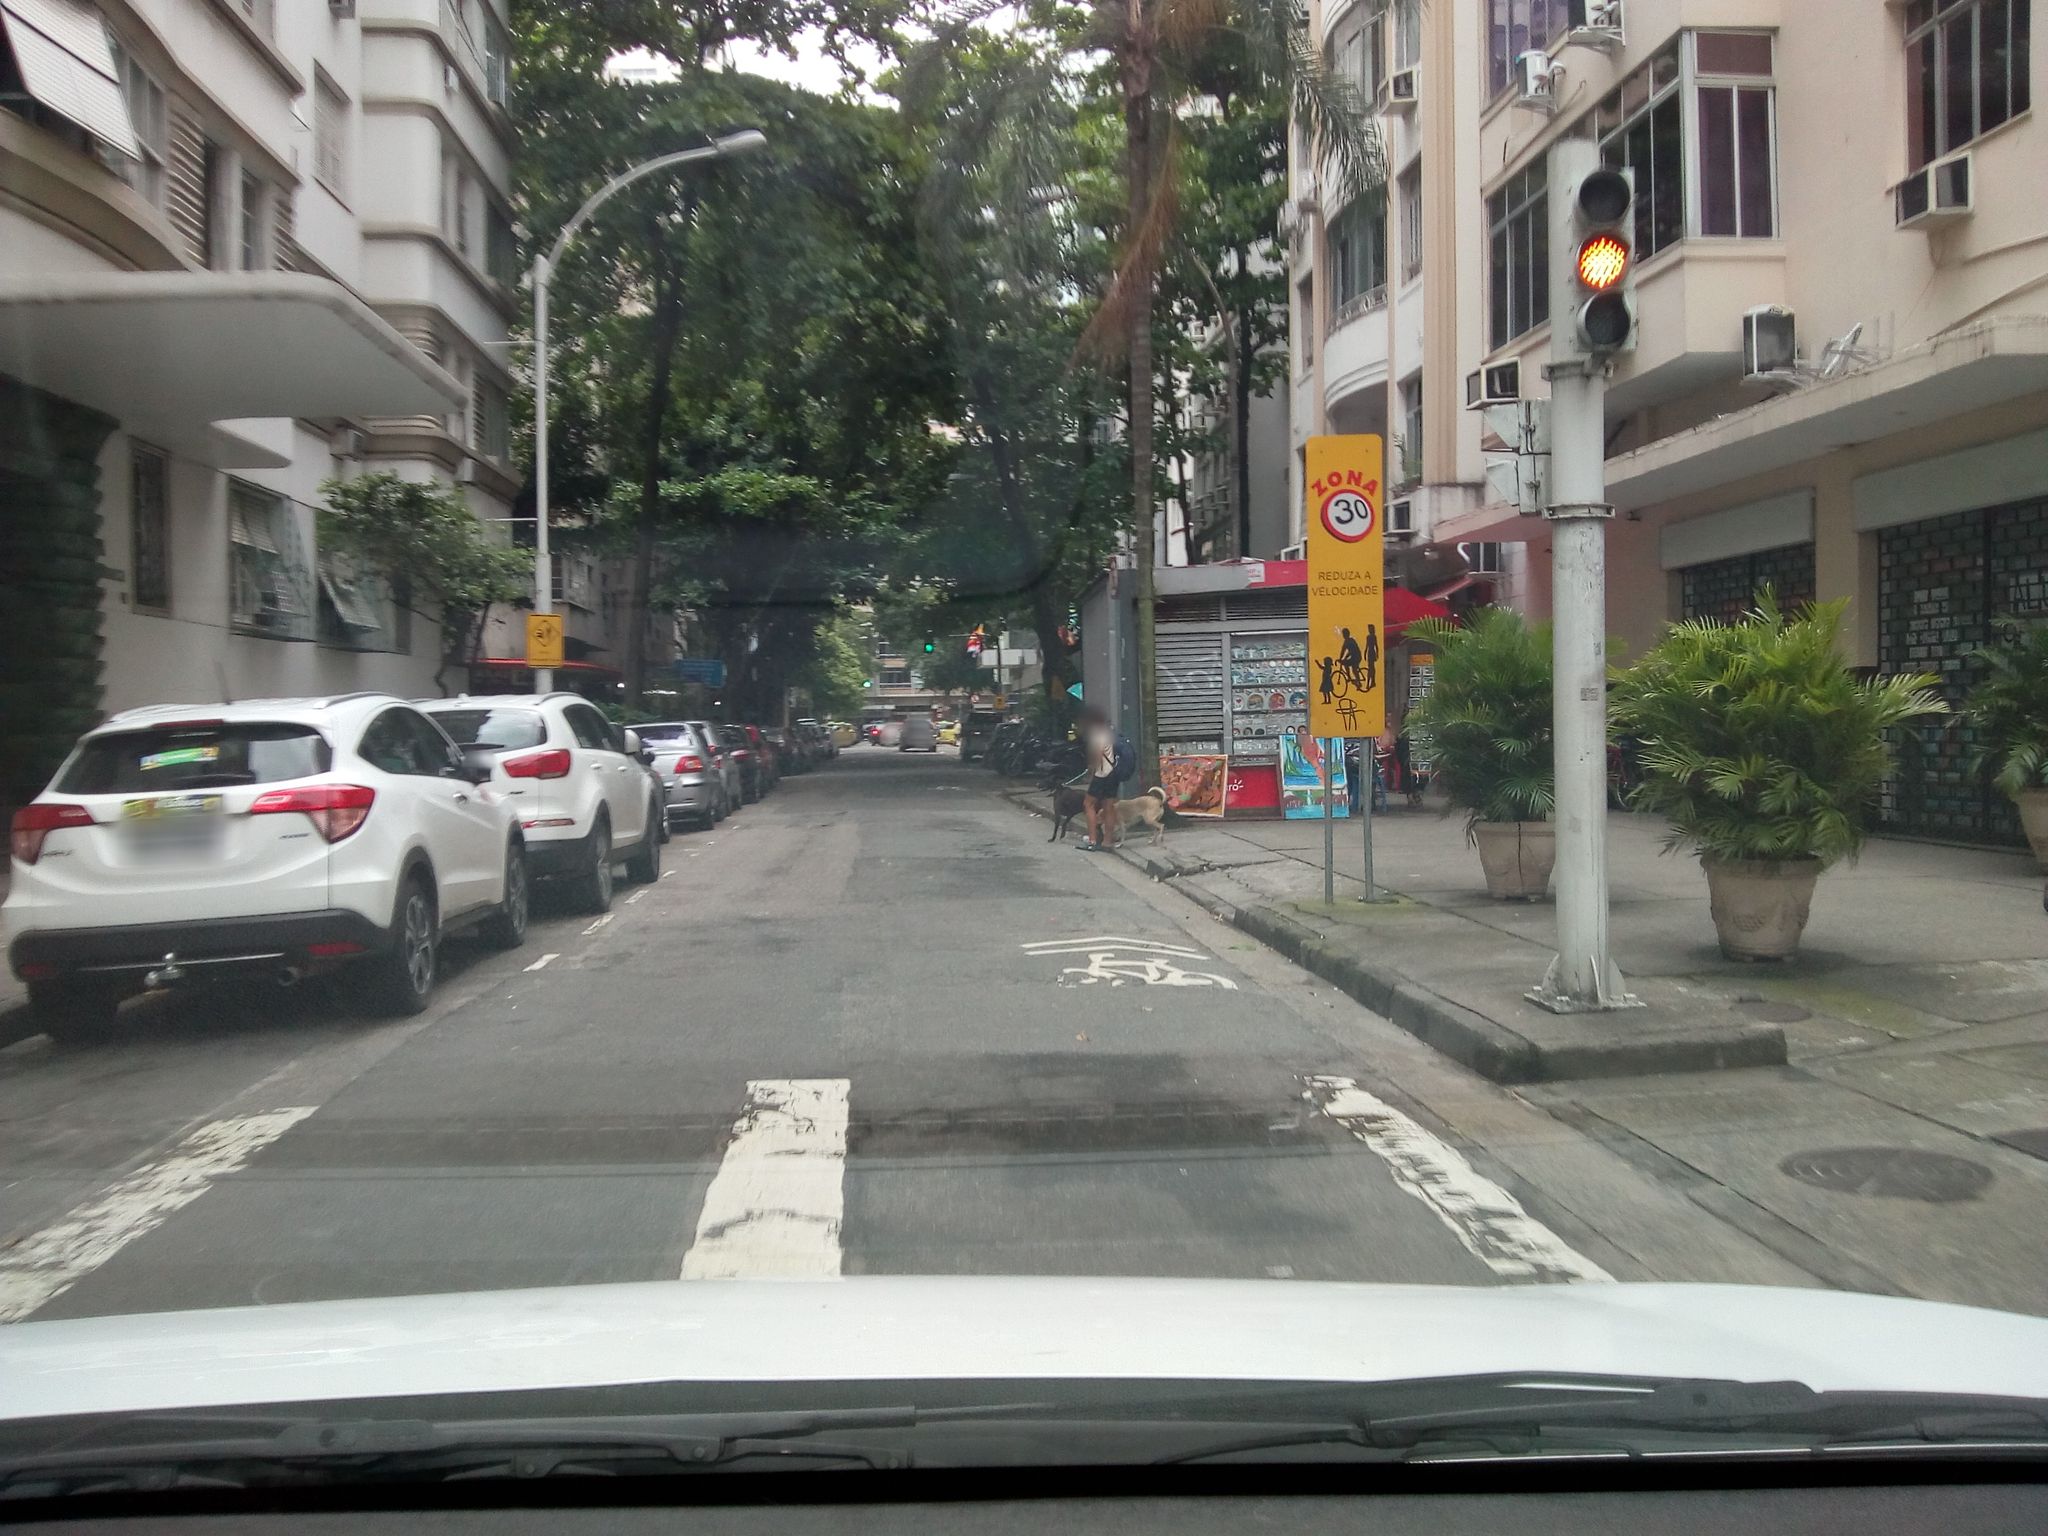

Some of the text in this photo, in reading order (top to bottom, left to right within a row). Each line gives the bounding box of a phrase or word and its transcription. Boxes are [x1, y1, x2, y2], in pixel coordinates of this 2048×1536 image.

[1312, 470, 1378, 497] ZONA
[1334, 499, 1368, 525] 30
[1318, 571, 1371, 581] REDUZA A
[1312, 586, 1378, 596] VELOCIDADE
